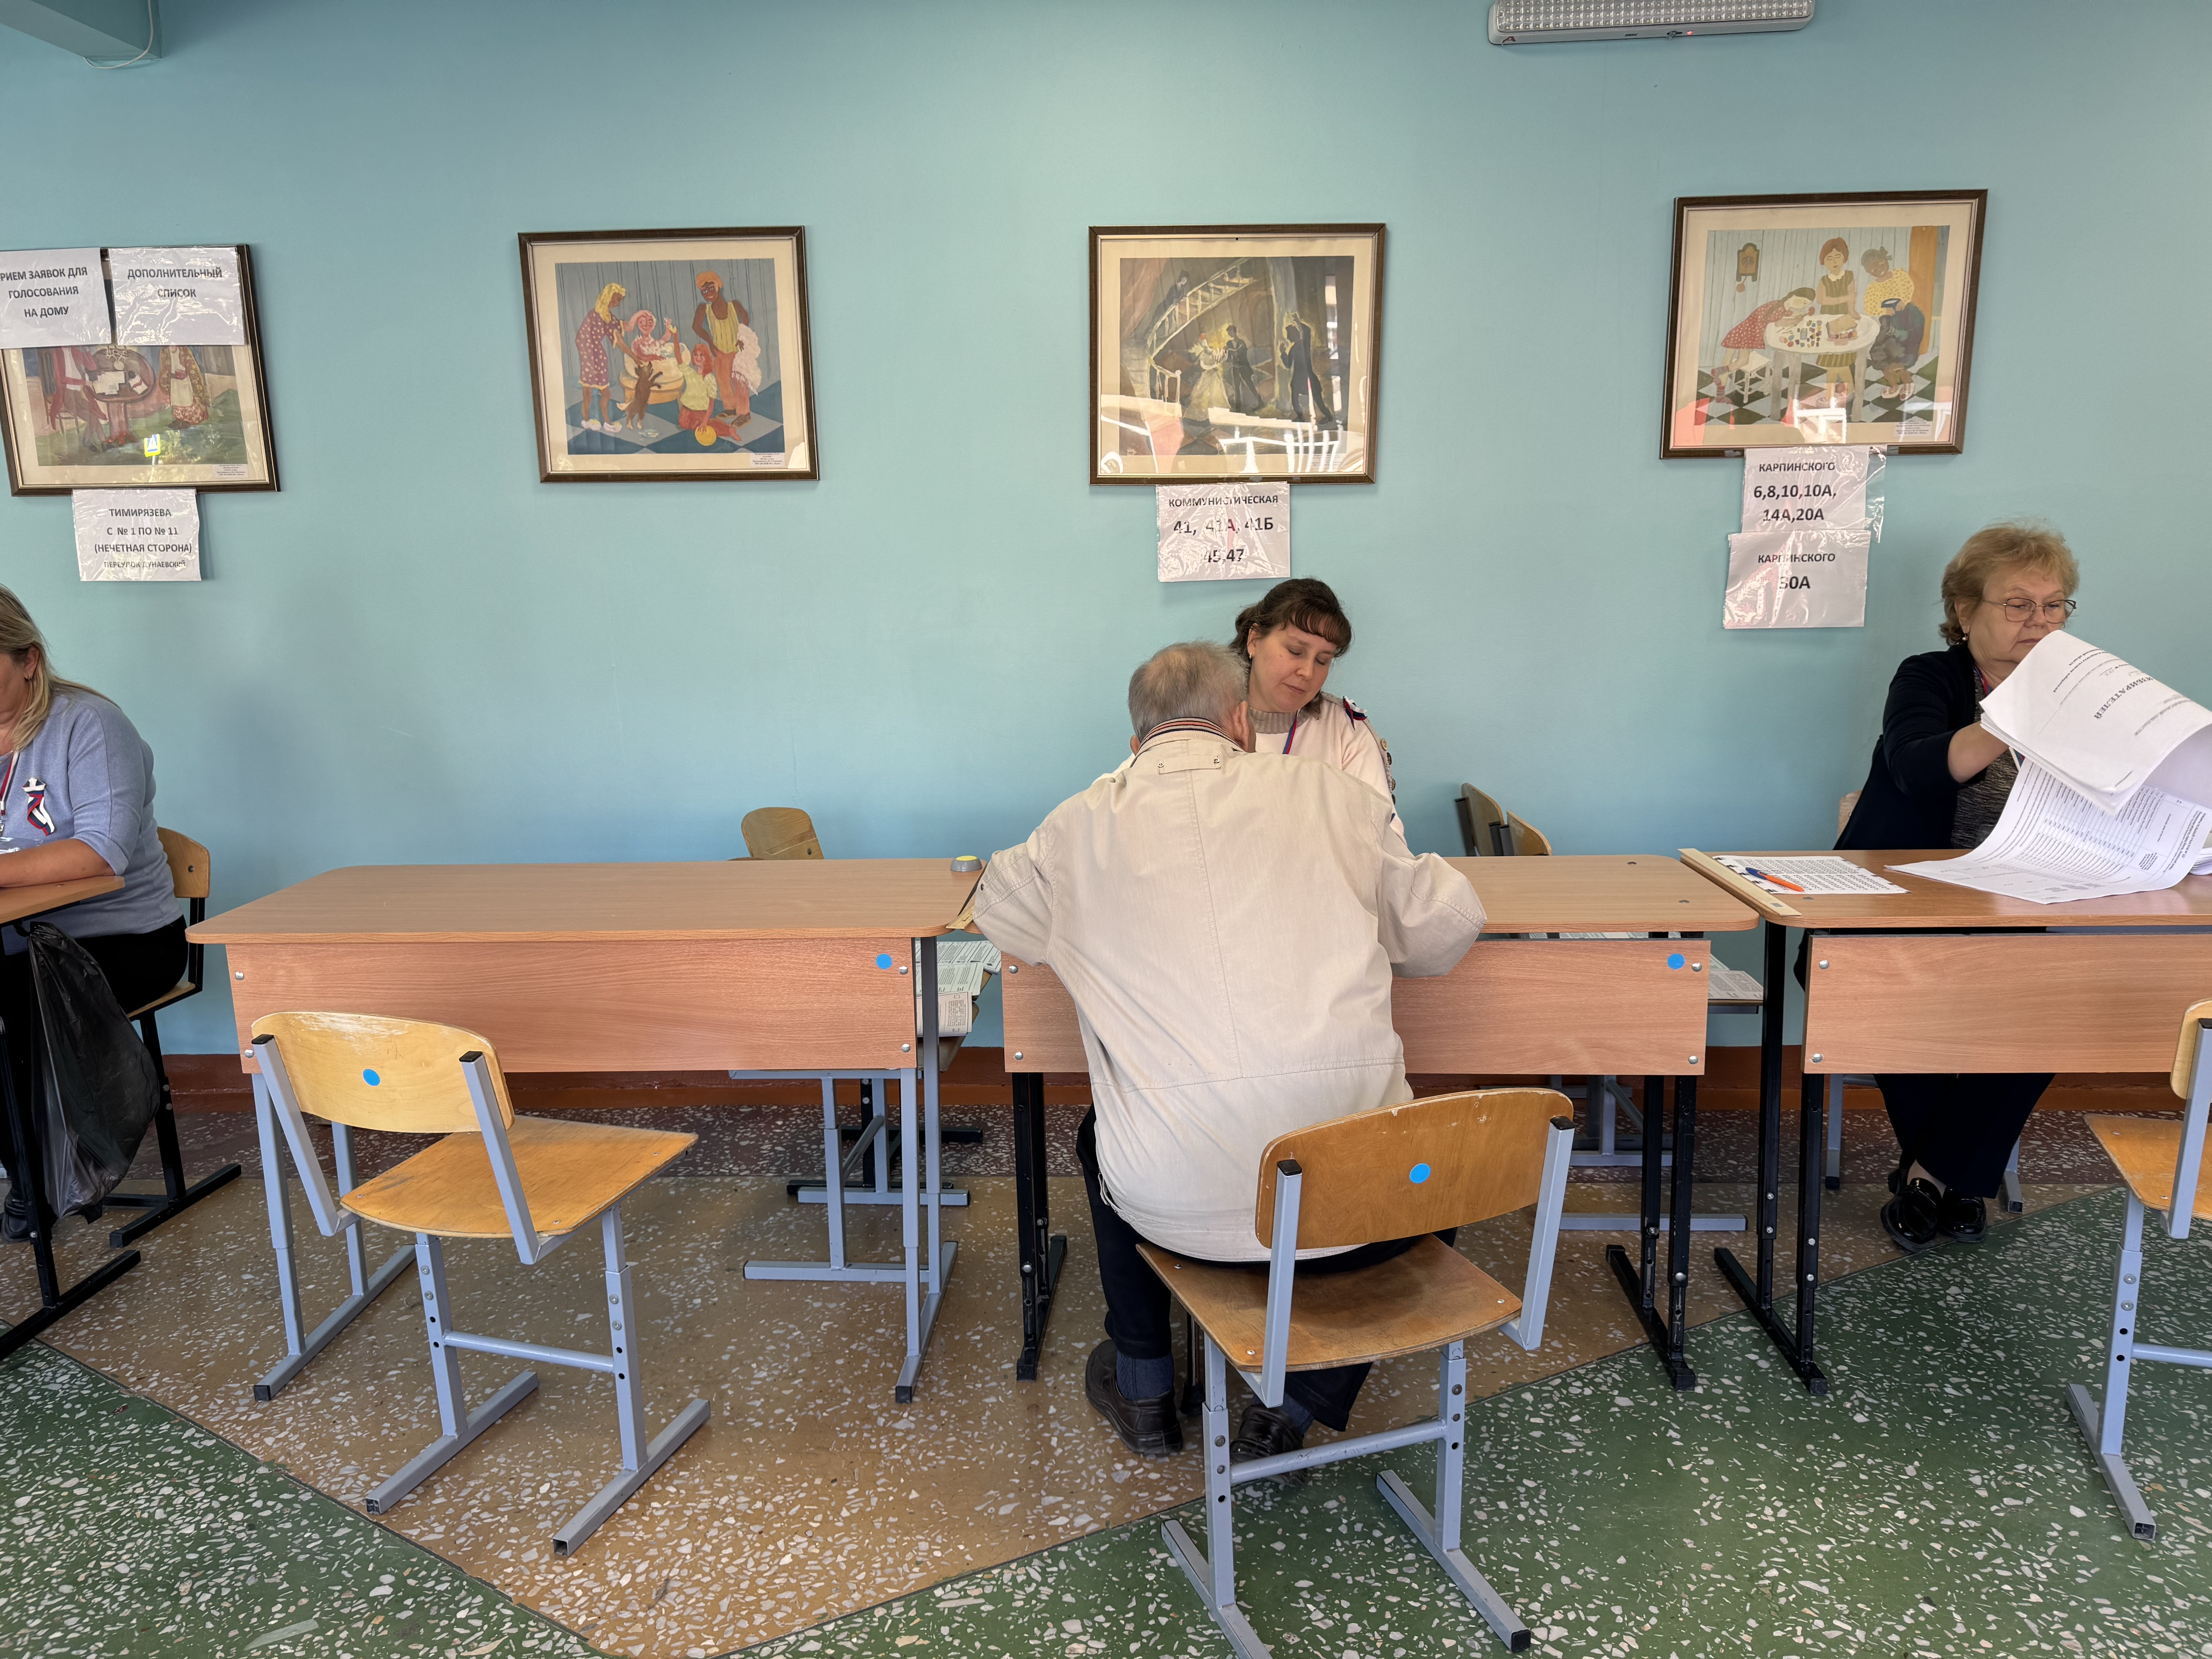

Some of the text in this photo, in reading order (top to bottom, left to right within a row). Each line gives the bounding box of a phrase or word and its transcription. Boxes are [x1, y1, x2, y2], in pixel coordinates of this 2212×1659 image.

[0, 266, 88, 282] РИЕМ ЗАЯВОК ДЛЯ
[127, 266, 222, 280] ДОПОЛНИТЕЛЬНЫЙ
[8, 286, 79, 299] ГОЛОСОВАНИЯ
[158, 289, 197, 298] СПИСОК
[24, 306, 69, 318] НА ДОМУ
[1759, 462, 1835, 472] КАРПИНСКОГО
[1753, 484, 1837, 500] 6,8,10,10А,
[1169, 495, 1278, 507] КОММУНИСТИЧЕСКАЯ
[109, 508, 172, 517] ТИМИРЯЗЕВА
[1763, 507, 1824, 523] 14А,20А
[107, 527, 113, 535] С
[138, 527, 152, 535] ПО
[1174, 520, 1197, 536] 41,
[1245, 517, 1273, 531] 41Б
[94, 543, 192, 554] (НЕЧЕТНАЯ СТОРОНА)
[142, 560, 185, 568] ДУНАЕВСКИЙ
[1758, 553, 1836, 563] КАРПИНСКОГО
[2094, 677, 2154, 719] ИЗБИРАТЕЛЕЙ
